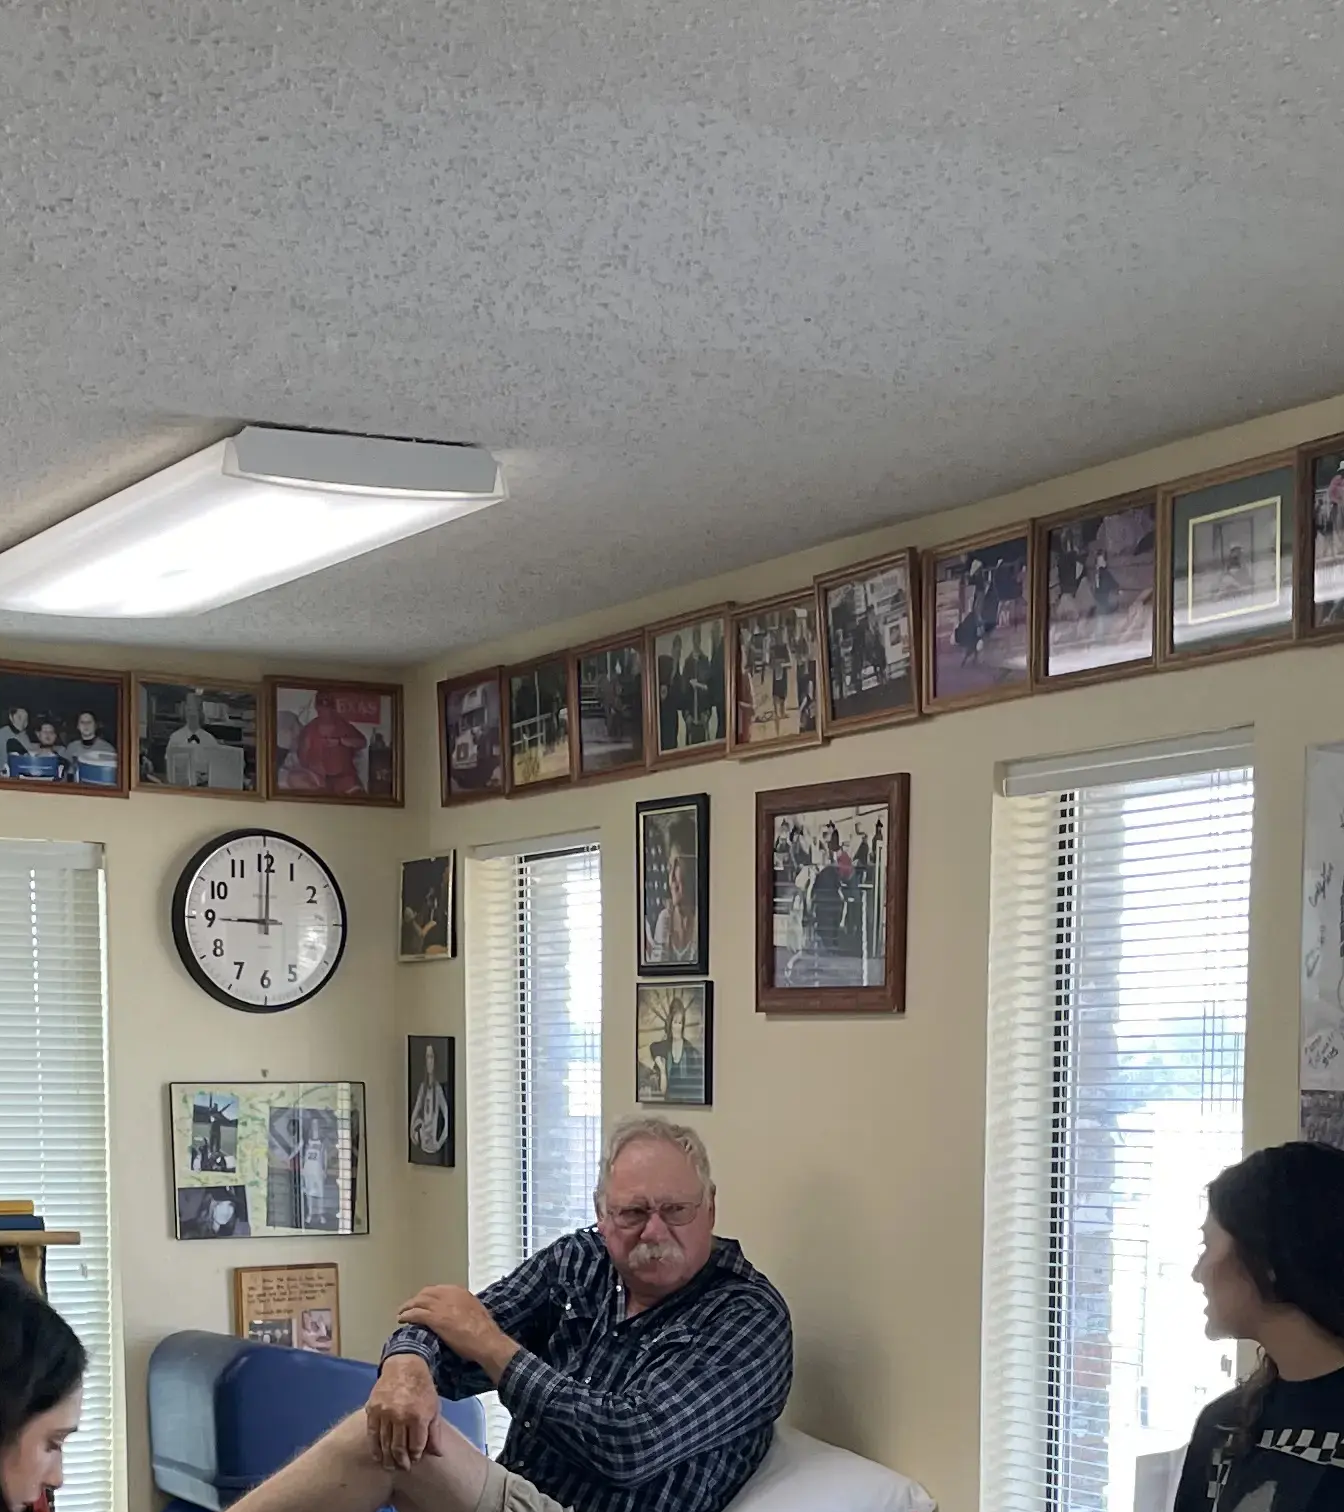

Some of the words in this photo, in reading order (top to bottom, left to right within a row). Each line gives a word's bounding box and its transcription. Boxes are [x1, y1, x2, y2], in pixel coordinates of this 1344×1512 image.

[231, 859, 245, 878] 11
[257, 851, 276, 873] 12
[289, 863, 295, 881] 1
[211, 881, 228, 900] 10
[306, 885, 318, 904] 2
[205, 909, 216, 928] 9
[212, 938, 224, 957] 8
[233, 961, 245, 980] 7
[260, 969, 271, 989] 6
[287, 964, 298, 983] 5
